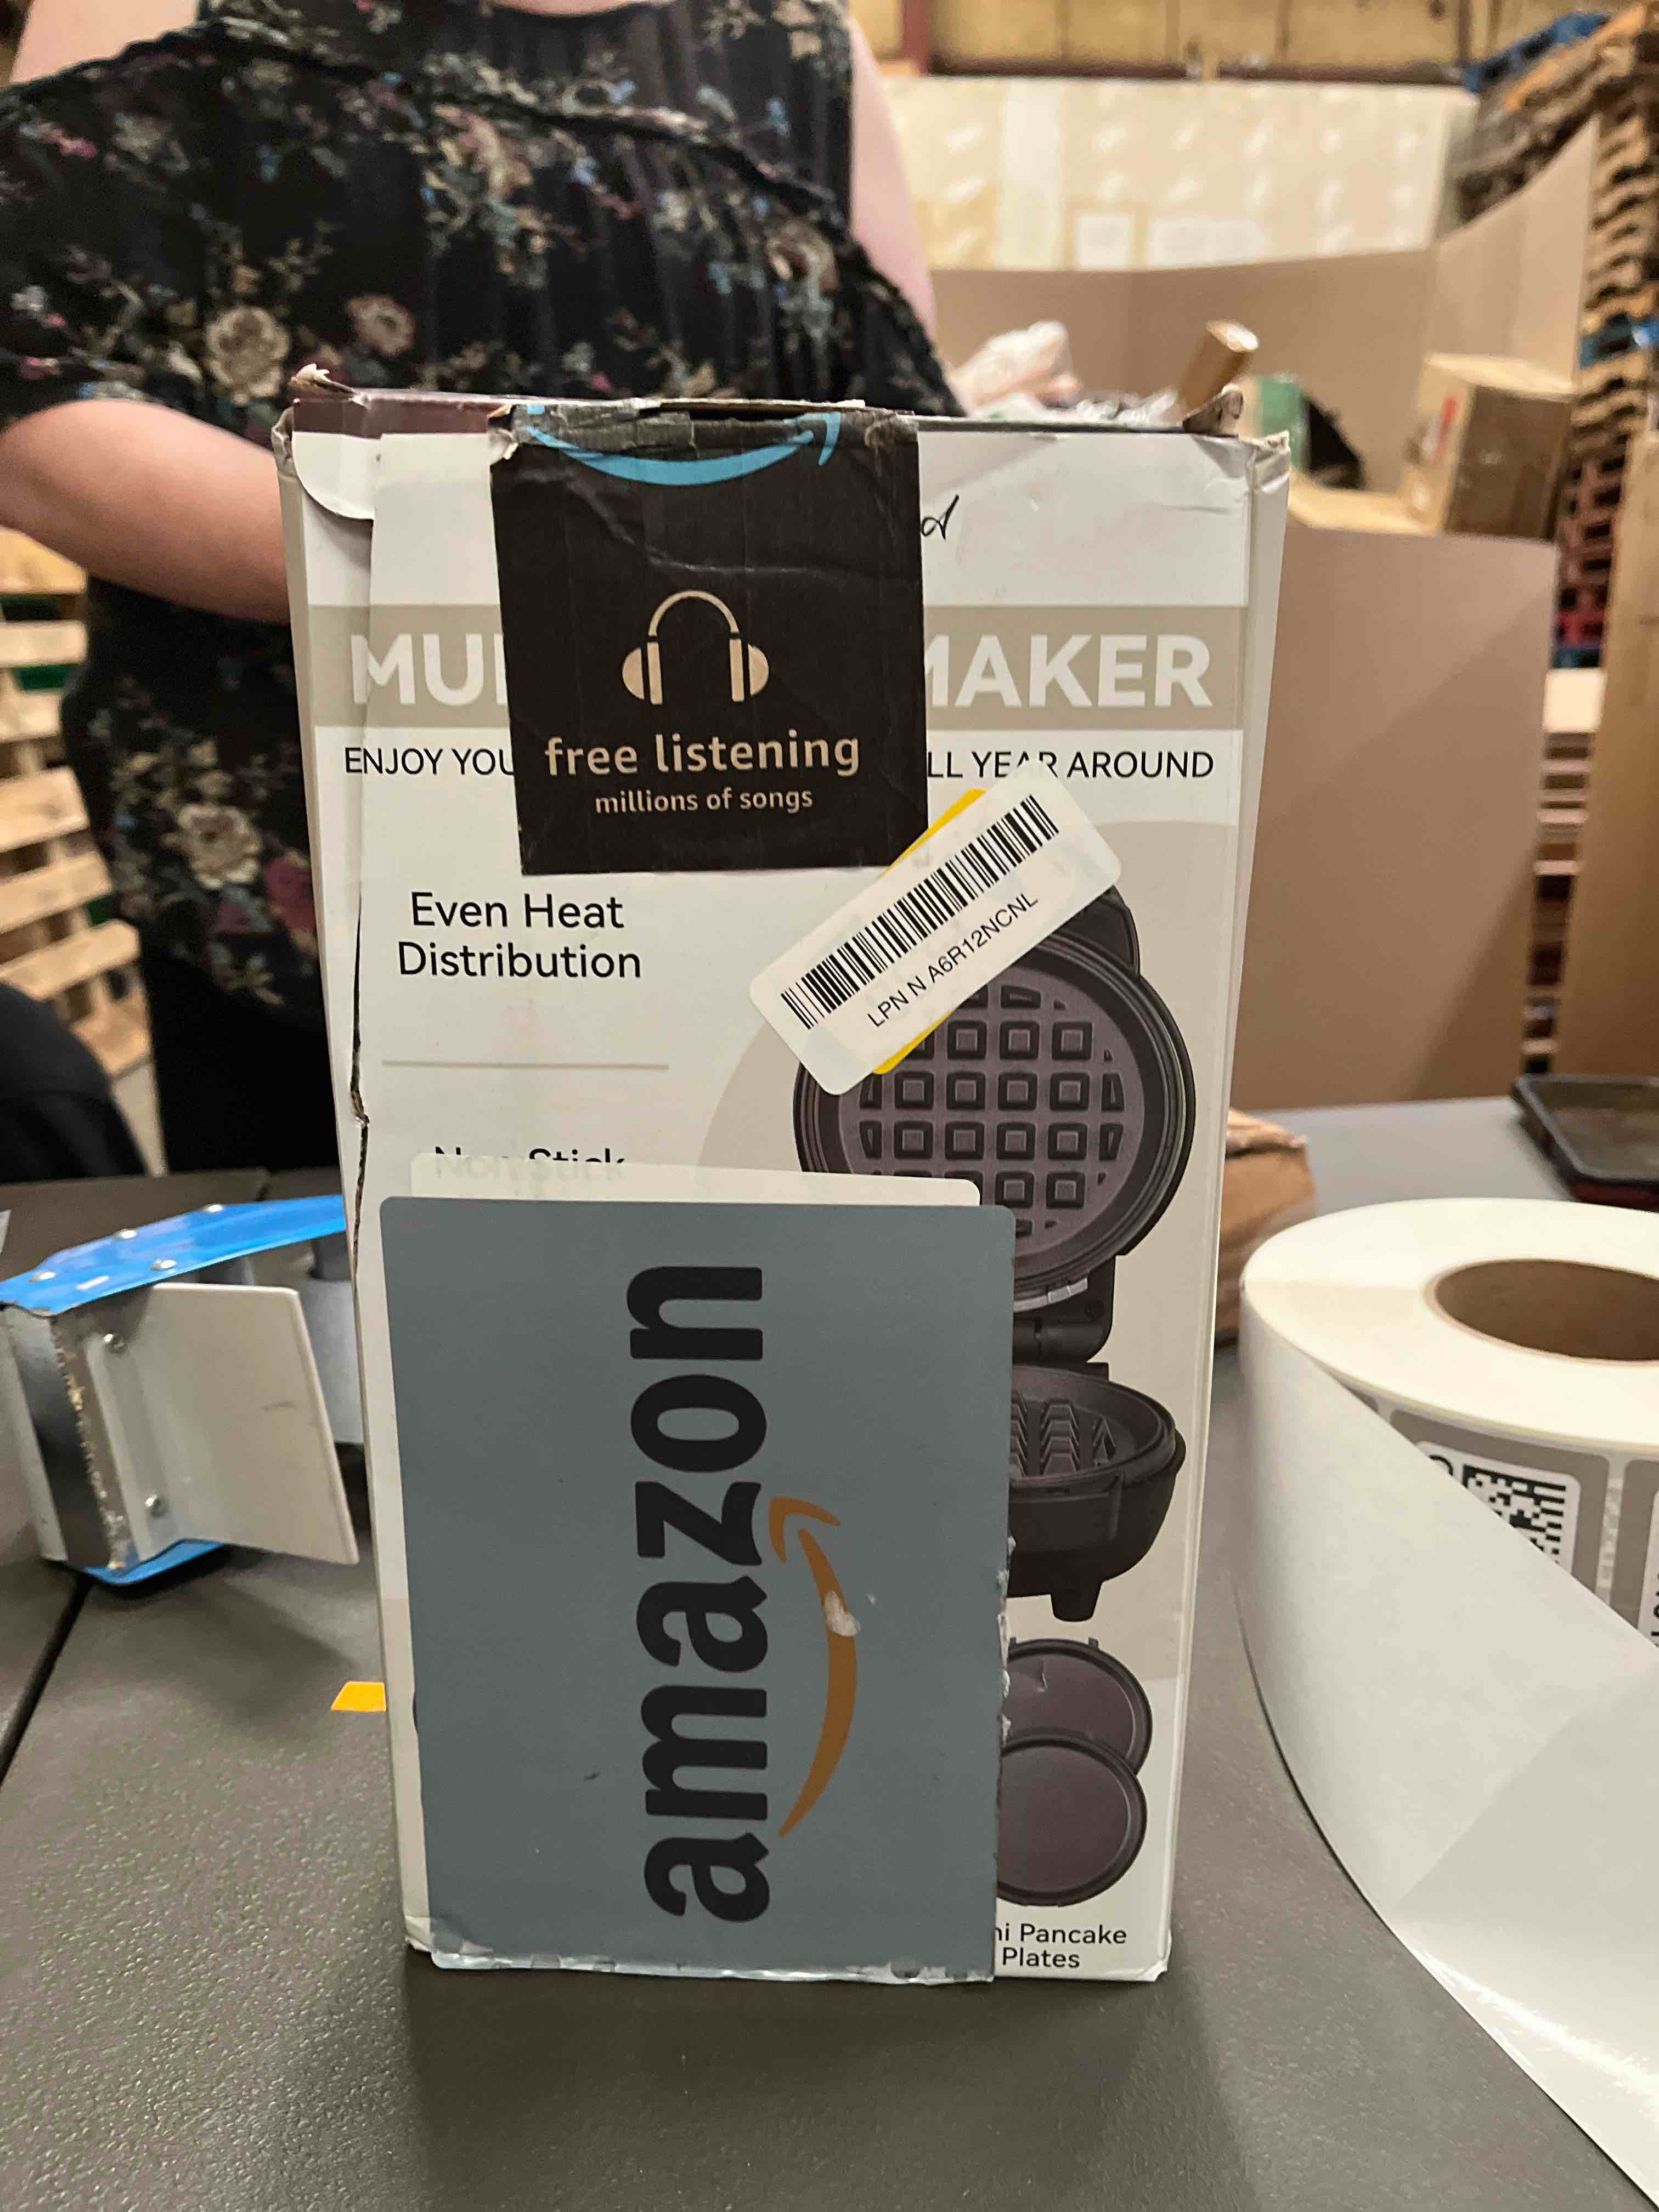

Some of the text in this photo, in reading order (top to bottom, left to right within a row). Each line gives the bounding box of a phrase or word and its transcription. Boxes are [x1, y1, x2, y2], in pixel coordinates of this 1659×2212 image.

[345, 747, 443, 775] ENJOY
[1066, 751, 1214, 778] AROUND
[545, 729, 859, 777] free listening
[595, 787, 813, 814] millions of songs
[411, 891, 624, 928] Even Heat
[398, 941, 641, 978] Distribution
[867, 894, 1039, 1027] LPN N A6R12NCNL
[626, 1265, 770, 1923] amazon
[1020, 1923, 1127, 1944] Pancake
[1002, 1947, 1080, 1968] Plates
